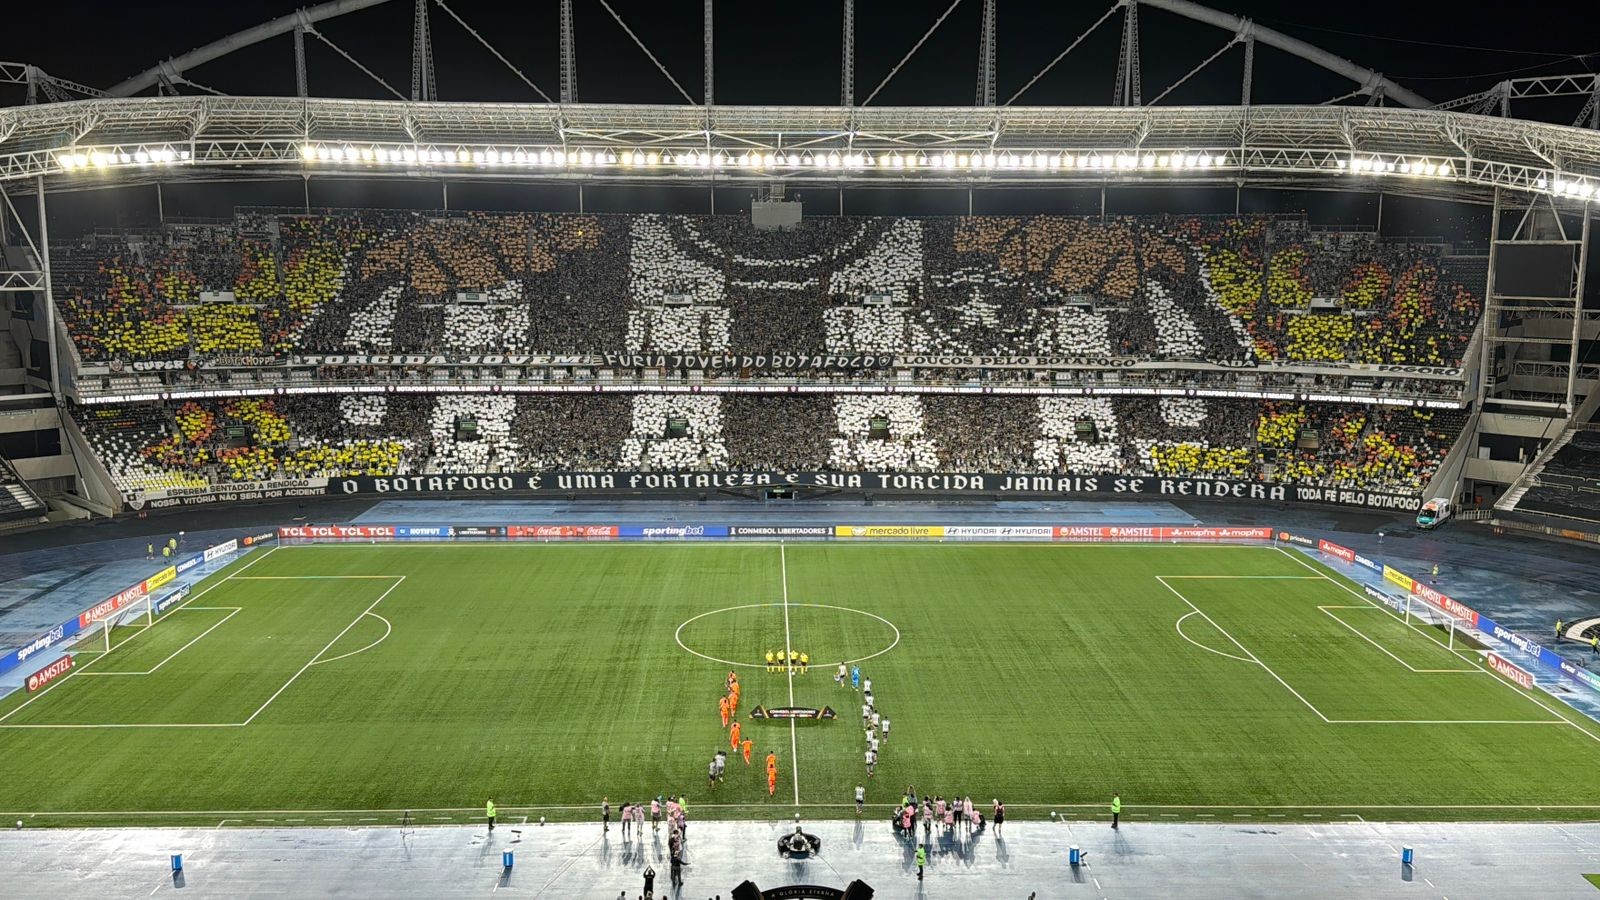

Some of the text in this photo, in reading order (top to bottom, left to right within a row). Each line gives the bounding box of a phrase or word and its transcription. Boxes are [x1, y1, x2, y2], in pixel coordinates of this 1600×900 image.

[303, 355, 581, 364] TORCIDA JOVEM
[671, 355, 737, 368] JOVEM
[742, 356, 767, 368] DO
[902, 356, 1136, 367] LOUCOS PELO BOTAFOGO
[166, 487, 208, 497] ESPEREM
[210, 482, 255, 492] SENTADOS
[342, 480, 358, 494] O
[374, 476, 513, 492] BOTAFOGO
[527, 472, 543, 490] É
[558, 474, 614, 489] UMA
[629, 473, 771, 489] FORTALEZA
[785, 473, 800, 484] E
[815, 473, 862, 488] SUA
[878, 474, 984, 490] TORCIDA
[1000, 476, 1098, 492] JAMAIS
[1114, 478, 1144, 493] SE
[151, 499, 181, 508] NOSSA
[265, 490, 283, 498] POR
[285, 488, 325, 496] ACIDENTE
[1296, 487, 1321, 500] TODA
[1339, 491, 1365, 505] PELO
[1368, 493, 1420, 511] BOTAFOGO
[282, 527, 306, 536] TCL
[310, 527, 335, 536] TCL
[339, 527, 363, 536] TCL
[367, 527, 392, 536] TCL
[643, 525, 705, 537] sportingbet
[870, 527, 929, 536] mercado livre
[1069, 528, 1104, 537] AMSTEL
[1120, 528, 1153, 537] AMSTEL
[1183, 529, 1216, 537] mapfre
[1231, 529, 1264, 537] mapfre
[121, 585, 143, 605] AMSTEL
[158, 584, 191, 611] sportingbet
[1420, 585, 1442, 604] AMSTEL
[91, 601, 115, 620] AMSTEL
[1451, 602, 1473, 622] AMSTEL
[17, 625, 64, 661] sportingbet
[1494, 626, 1541, 658] sportingbet
[38, 656, 70, 686] AMSTEL
[1497, 661, 1529, 689] AMSTEL
